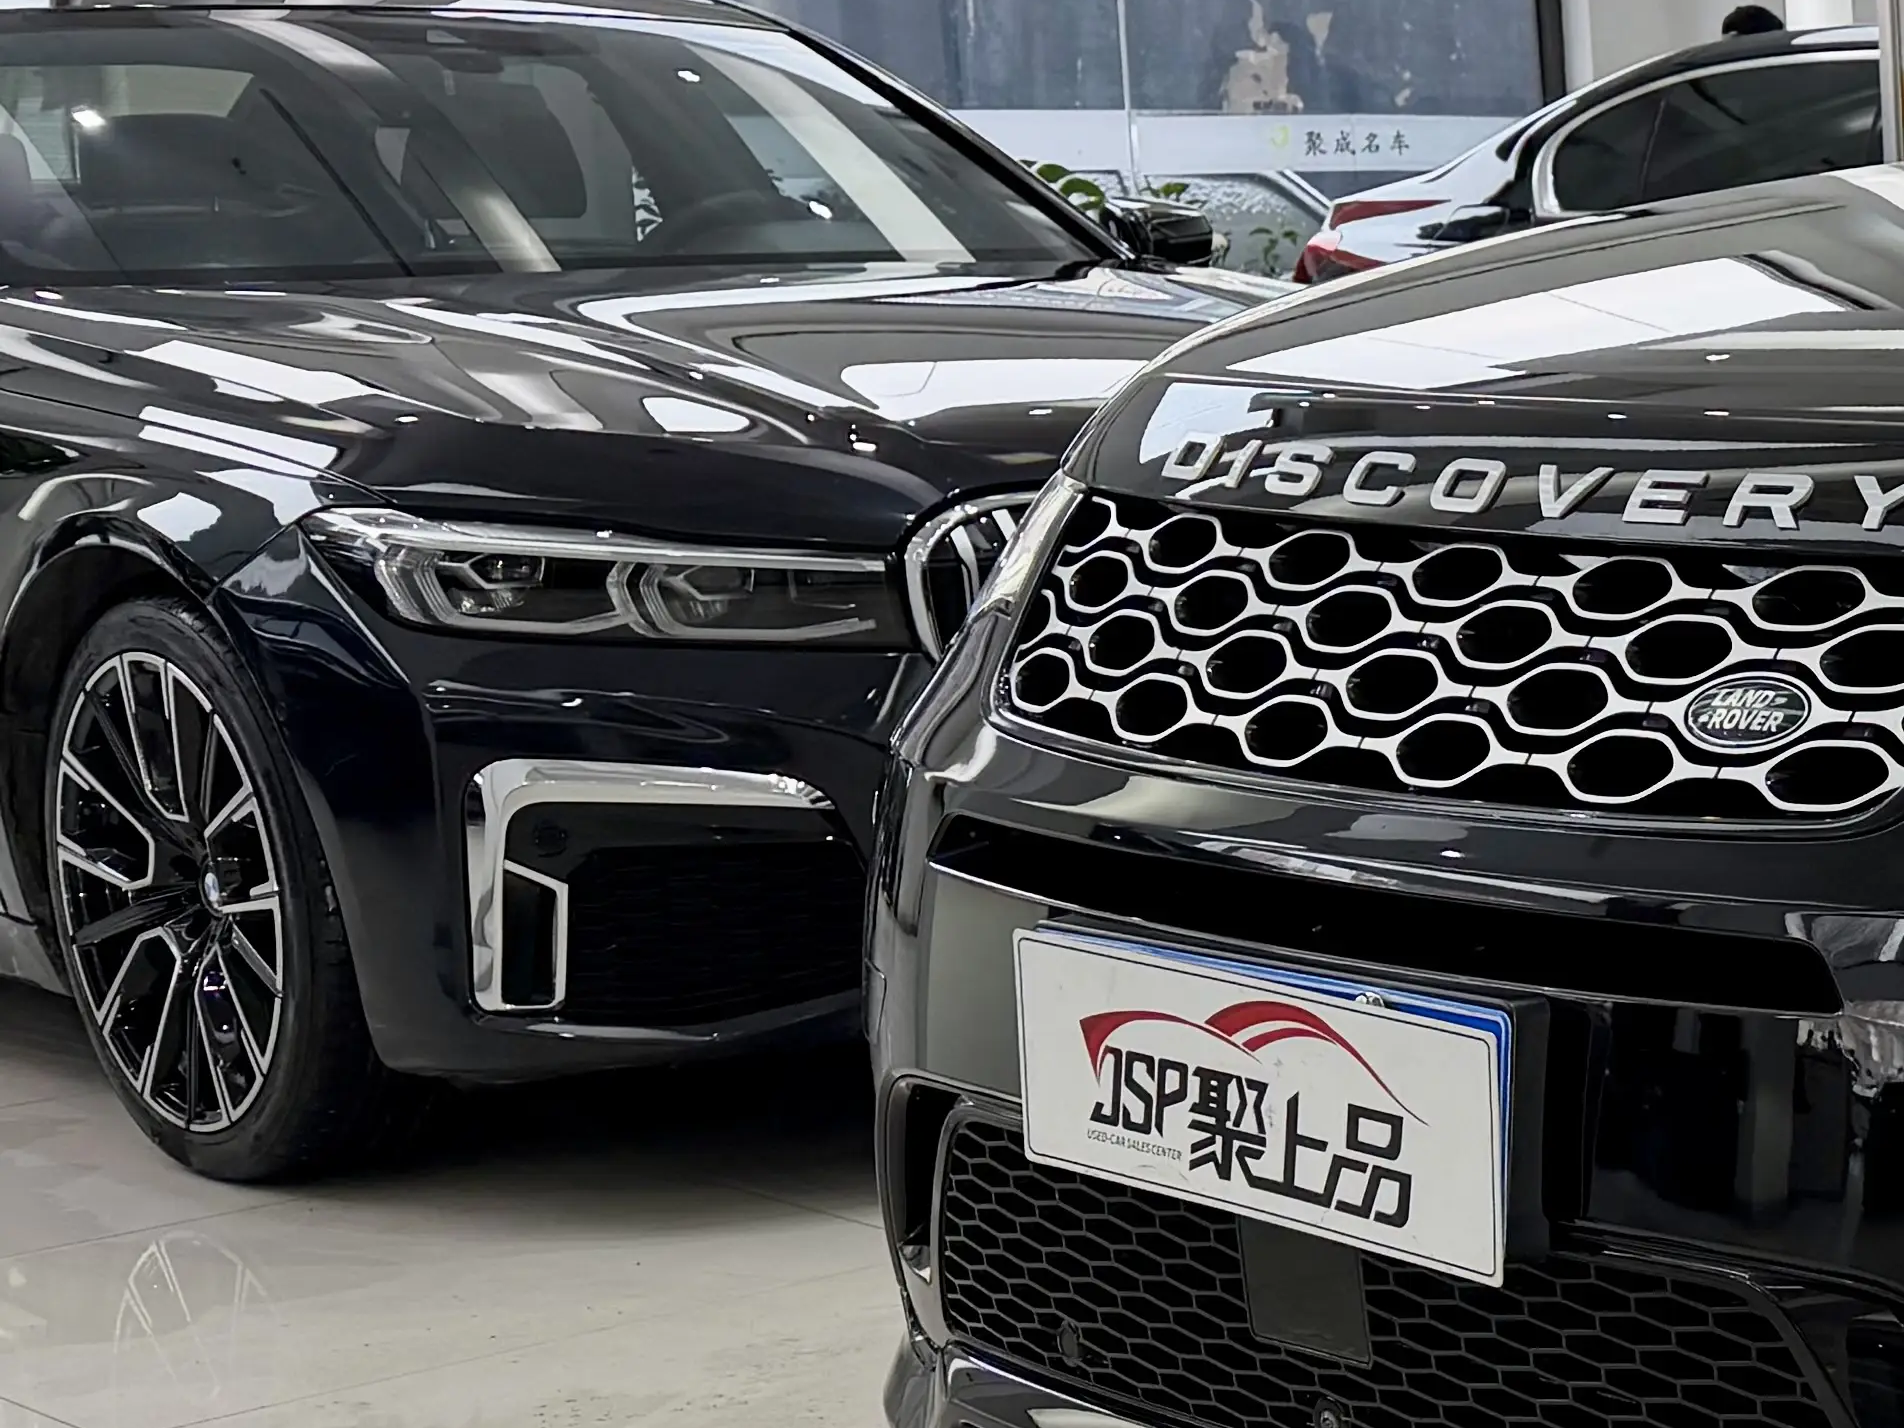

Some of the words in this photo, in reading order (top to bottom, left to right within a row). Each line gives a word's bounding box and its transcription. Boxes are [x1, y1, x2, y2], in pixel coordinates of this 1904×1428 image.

[1304, 129, 1411, 157] 聚成名车
[1711, 688, 1776, 708] LAND
[1707, 707, 1785, 733] ROVER
